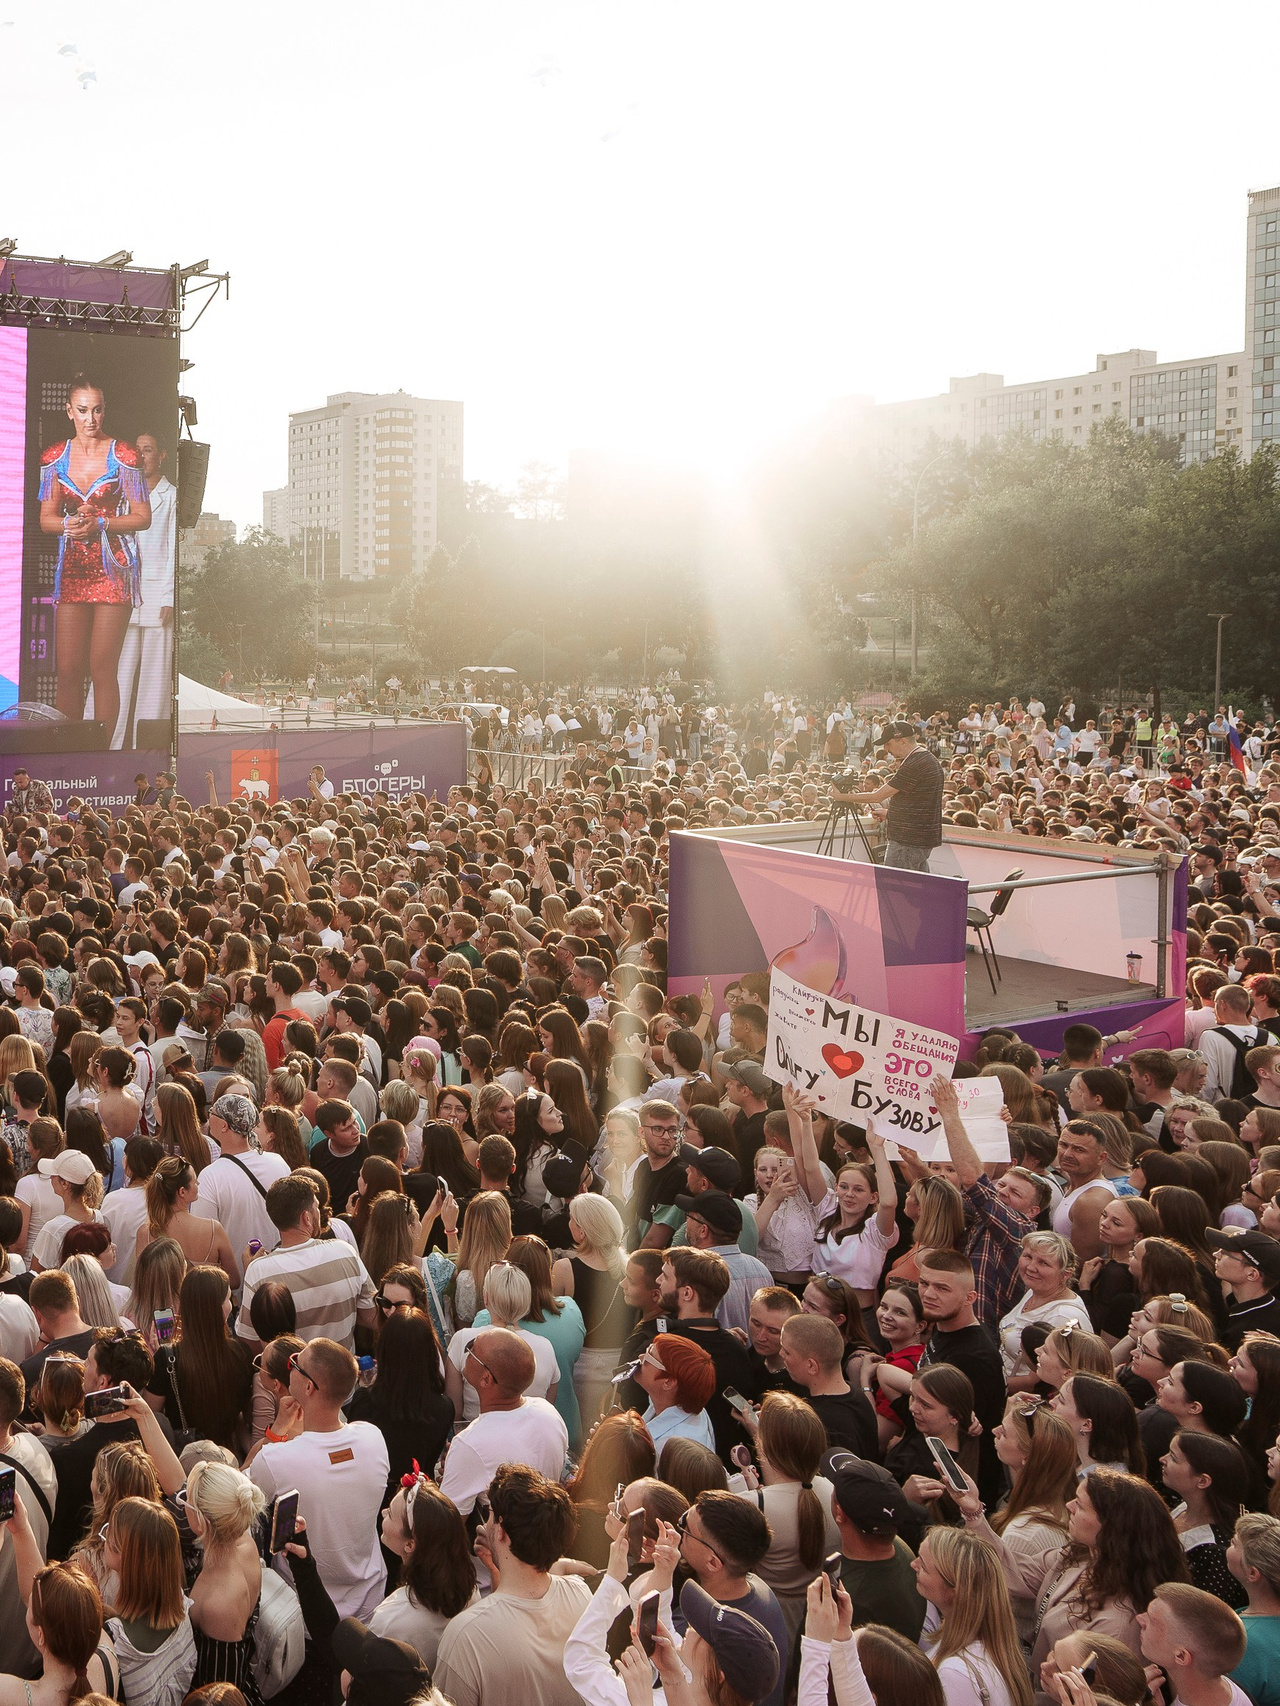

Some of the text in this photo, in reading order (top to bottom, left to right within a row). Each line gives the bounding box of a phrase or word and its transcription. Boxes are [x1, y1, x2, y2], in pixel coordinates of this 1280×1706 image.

[342, 775, 426, 794] БЛОГЕРЫ
[822, 1000, 881, 1047] МЫ
[895, 1028, 958, 1053] Я УДАЛЯЮ
[884, 1052, 933, 1078] ЭТО
[884, 1075, 919, 1092] ВСЕГО
[886, 1085, 921, 1101] СЛОВА
[851, 1079, 942, 1135] БУЗОВУ
